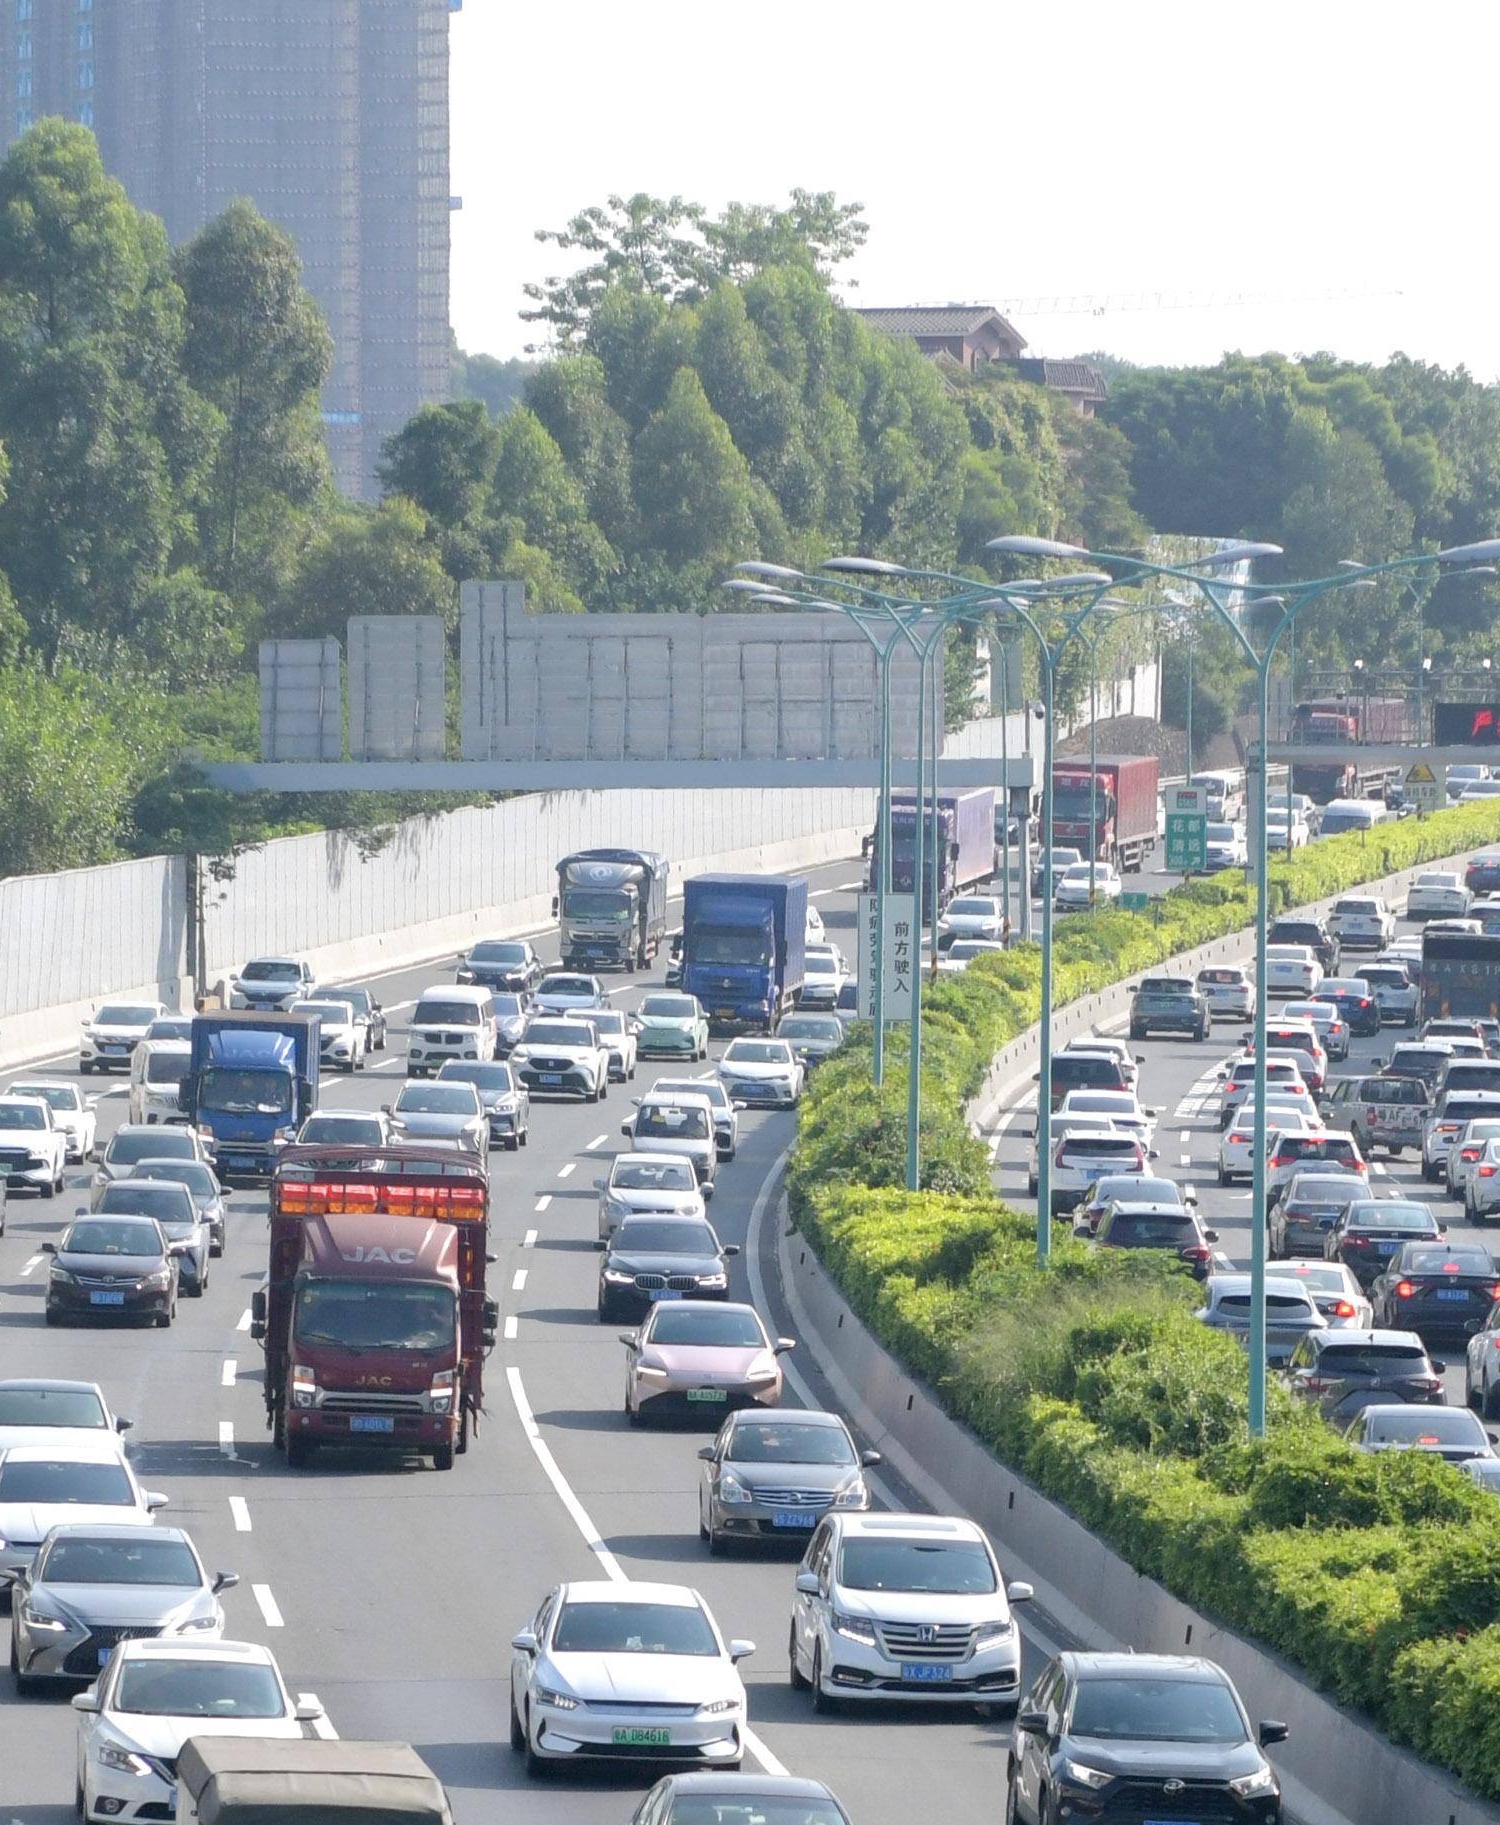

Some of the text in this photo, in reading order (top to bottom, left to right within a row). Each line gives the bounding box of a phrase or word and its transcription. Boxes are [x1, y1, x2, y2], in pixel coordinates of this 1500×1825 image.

[894, 921, 910, 993] 前方驶入
[342, 1246, 417, 1264] JAC
[355, 1375, 392, 1386] JAC
